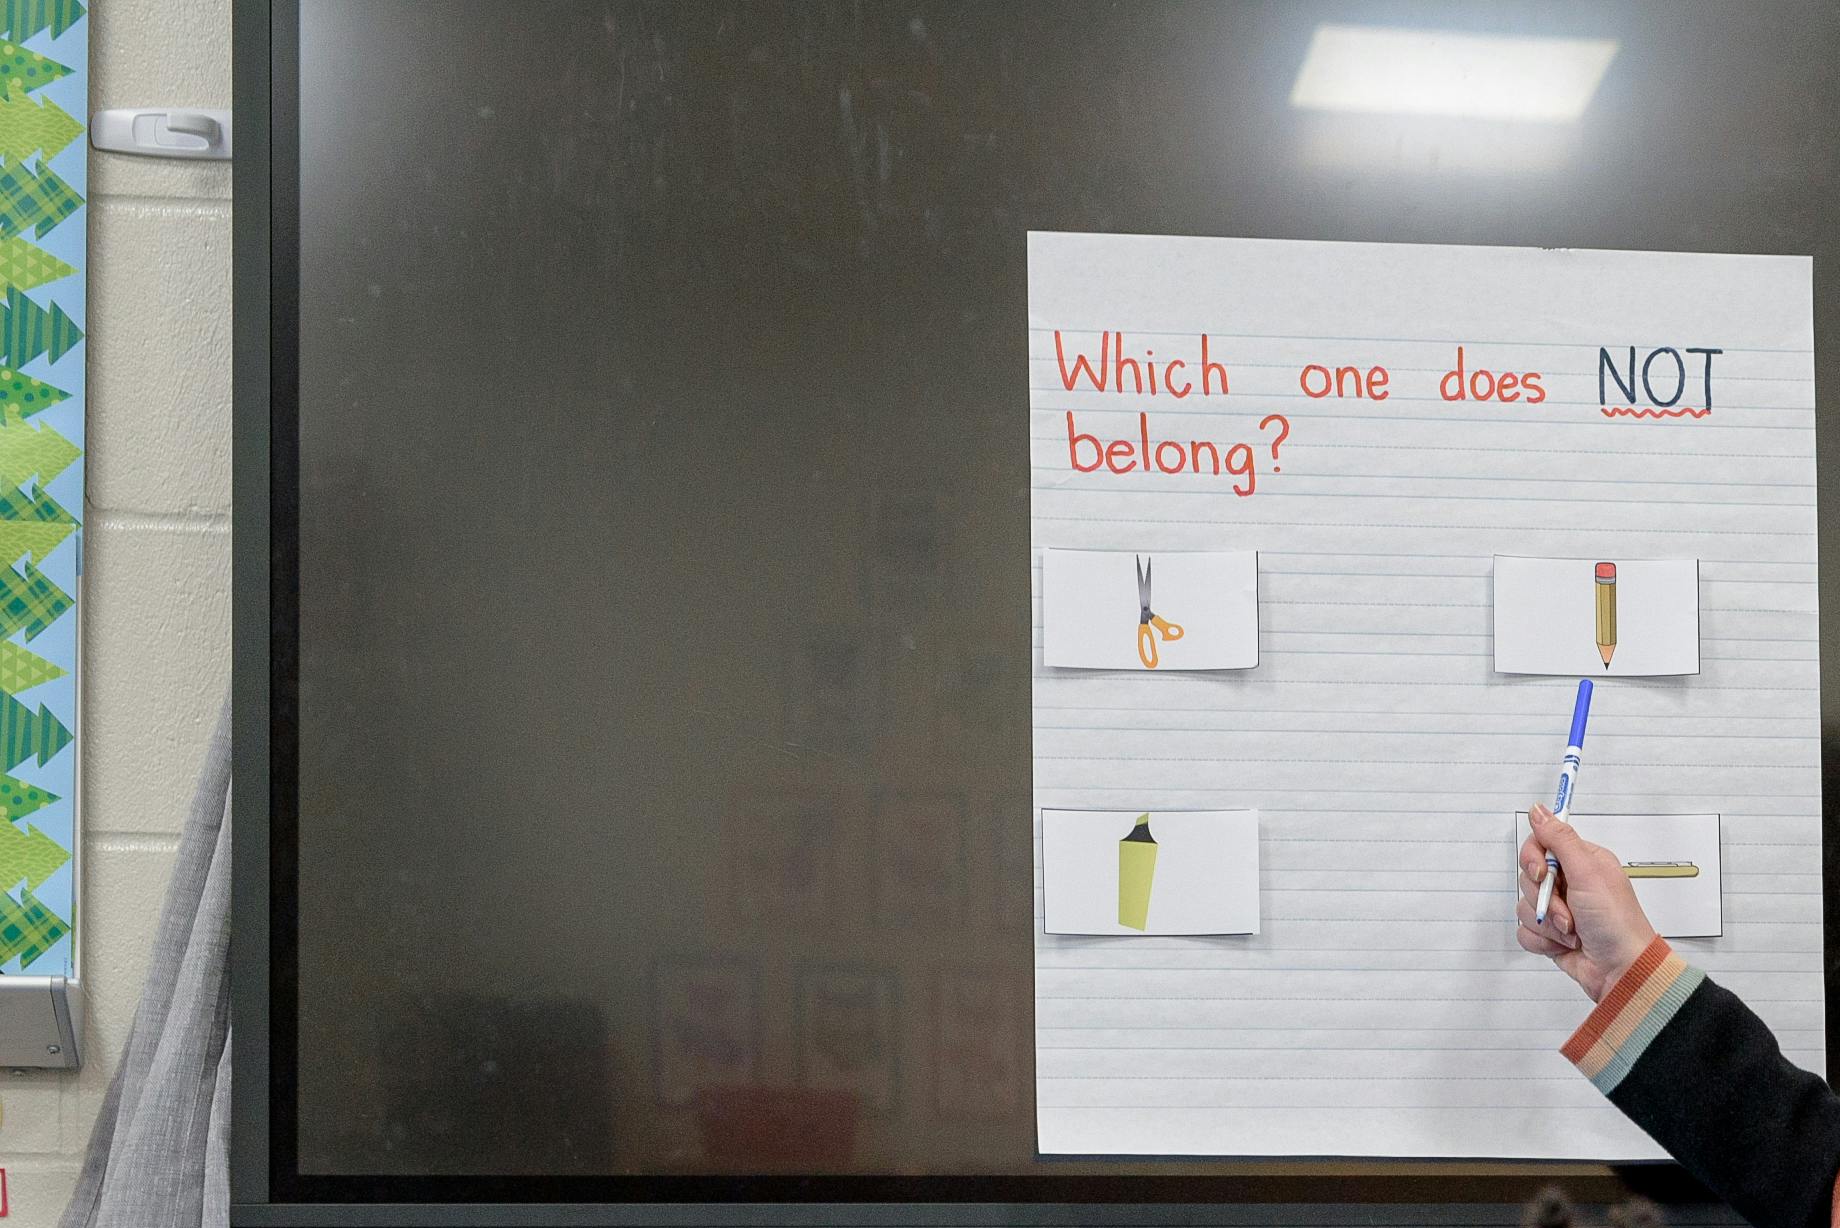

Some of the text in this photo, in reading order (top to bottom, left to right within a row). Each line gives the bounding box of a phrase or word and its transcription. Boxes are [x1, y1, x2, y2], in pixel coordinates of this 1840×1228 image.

[1054, 330, 1723, 413] Which one does NOT
[1066, 411, 1290, 497] belong?
